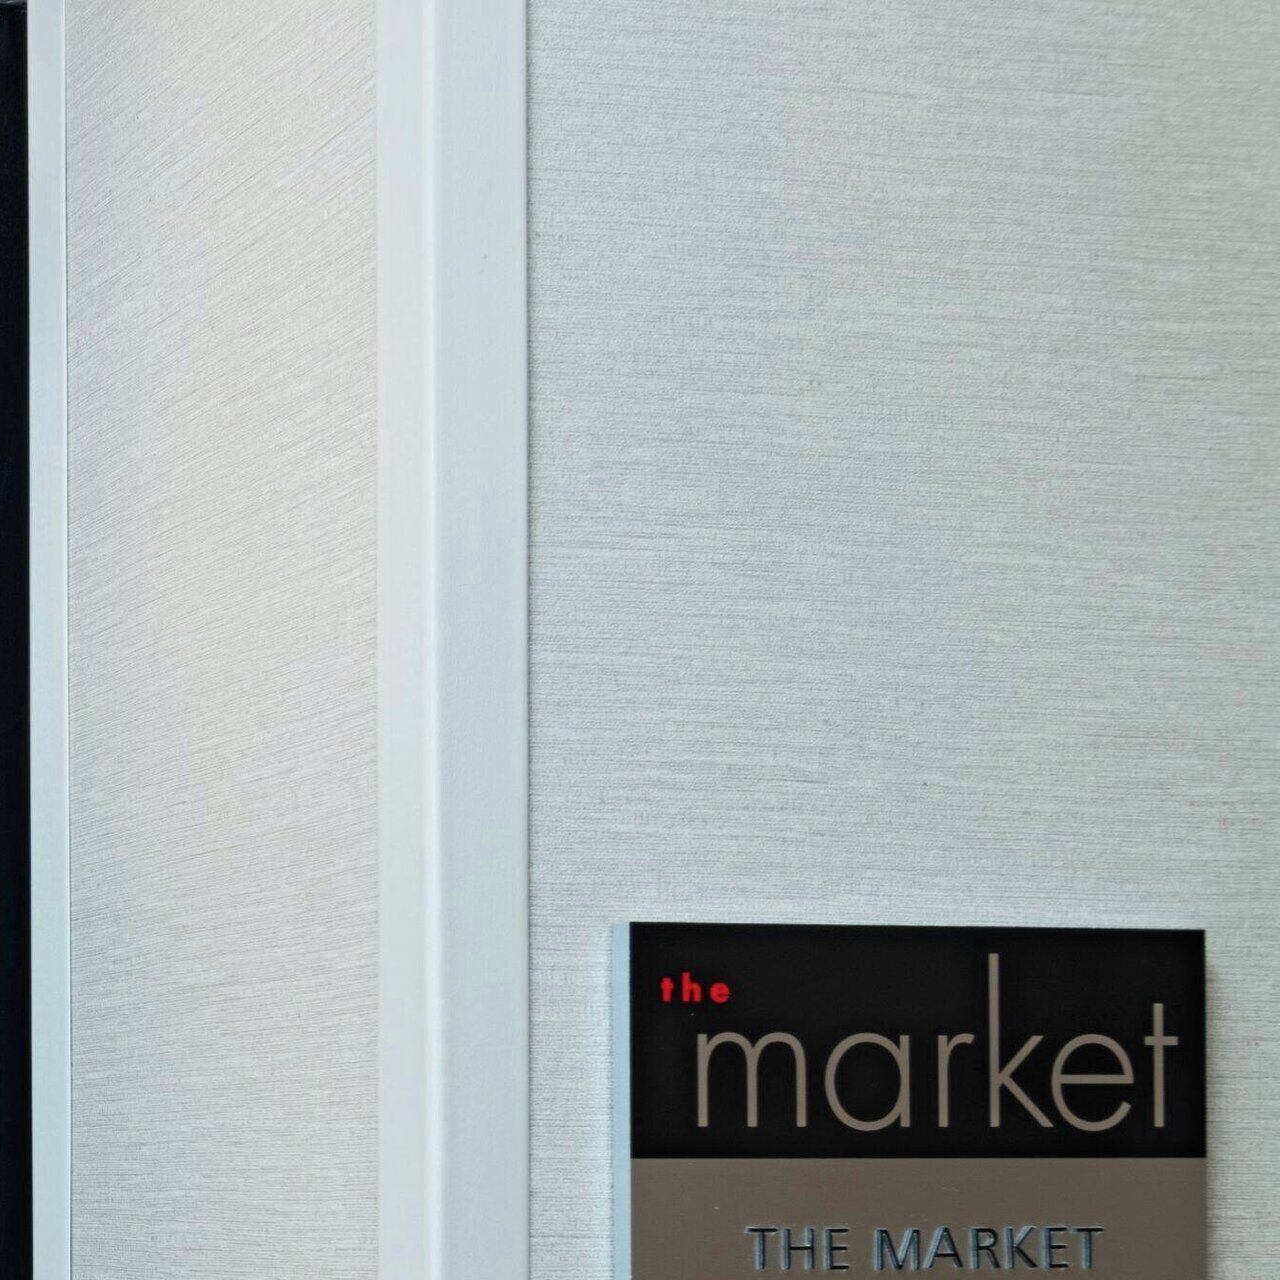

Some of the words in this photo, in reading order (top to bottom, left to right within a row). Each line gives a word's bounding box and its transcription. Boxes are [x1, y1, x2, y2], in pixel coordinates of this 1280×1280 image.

[659, 972, 730, 1003] the
[696, 952, 1179, 1132] market
[744, 1225, 851, 1271] THE
[872, 1225, 1105, 1271] MARKET
